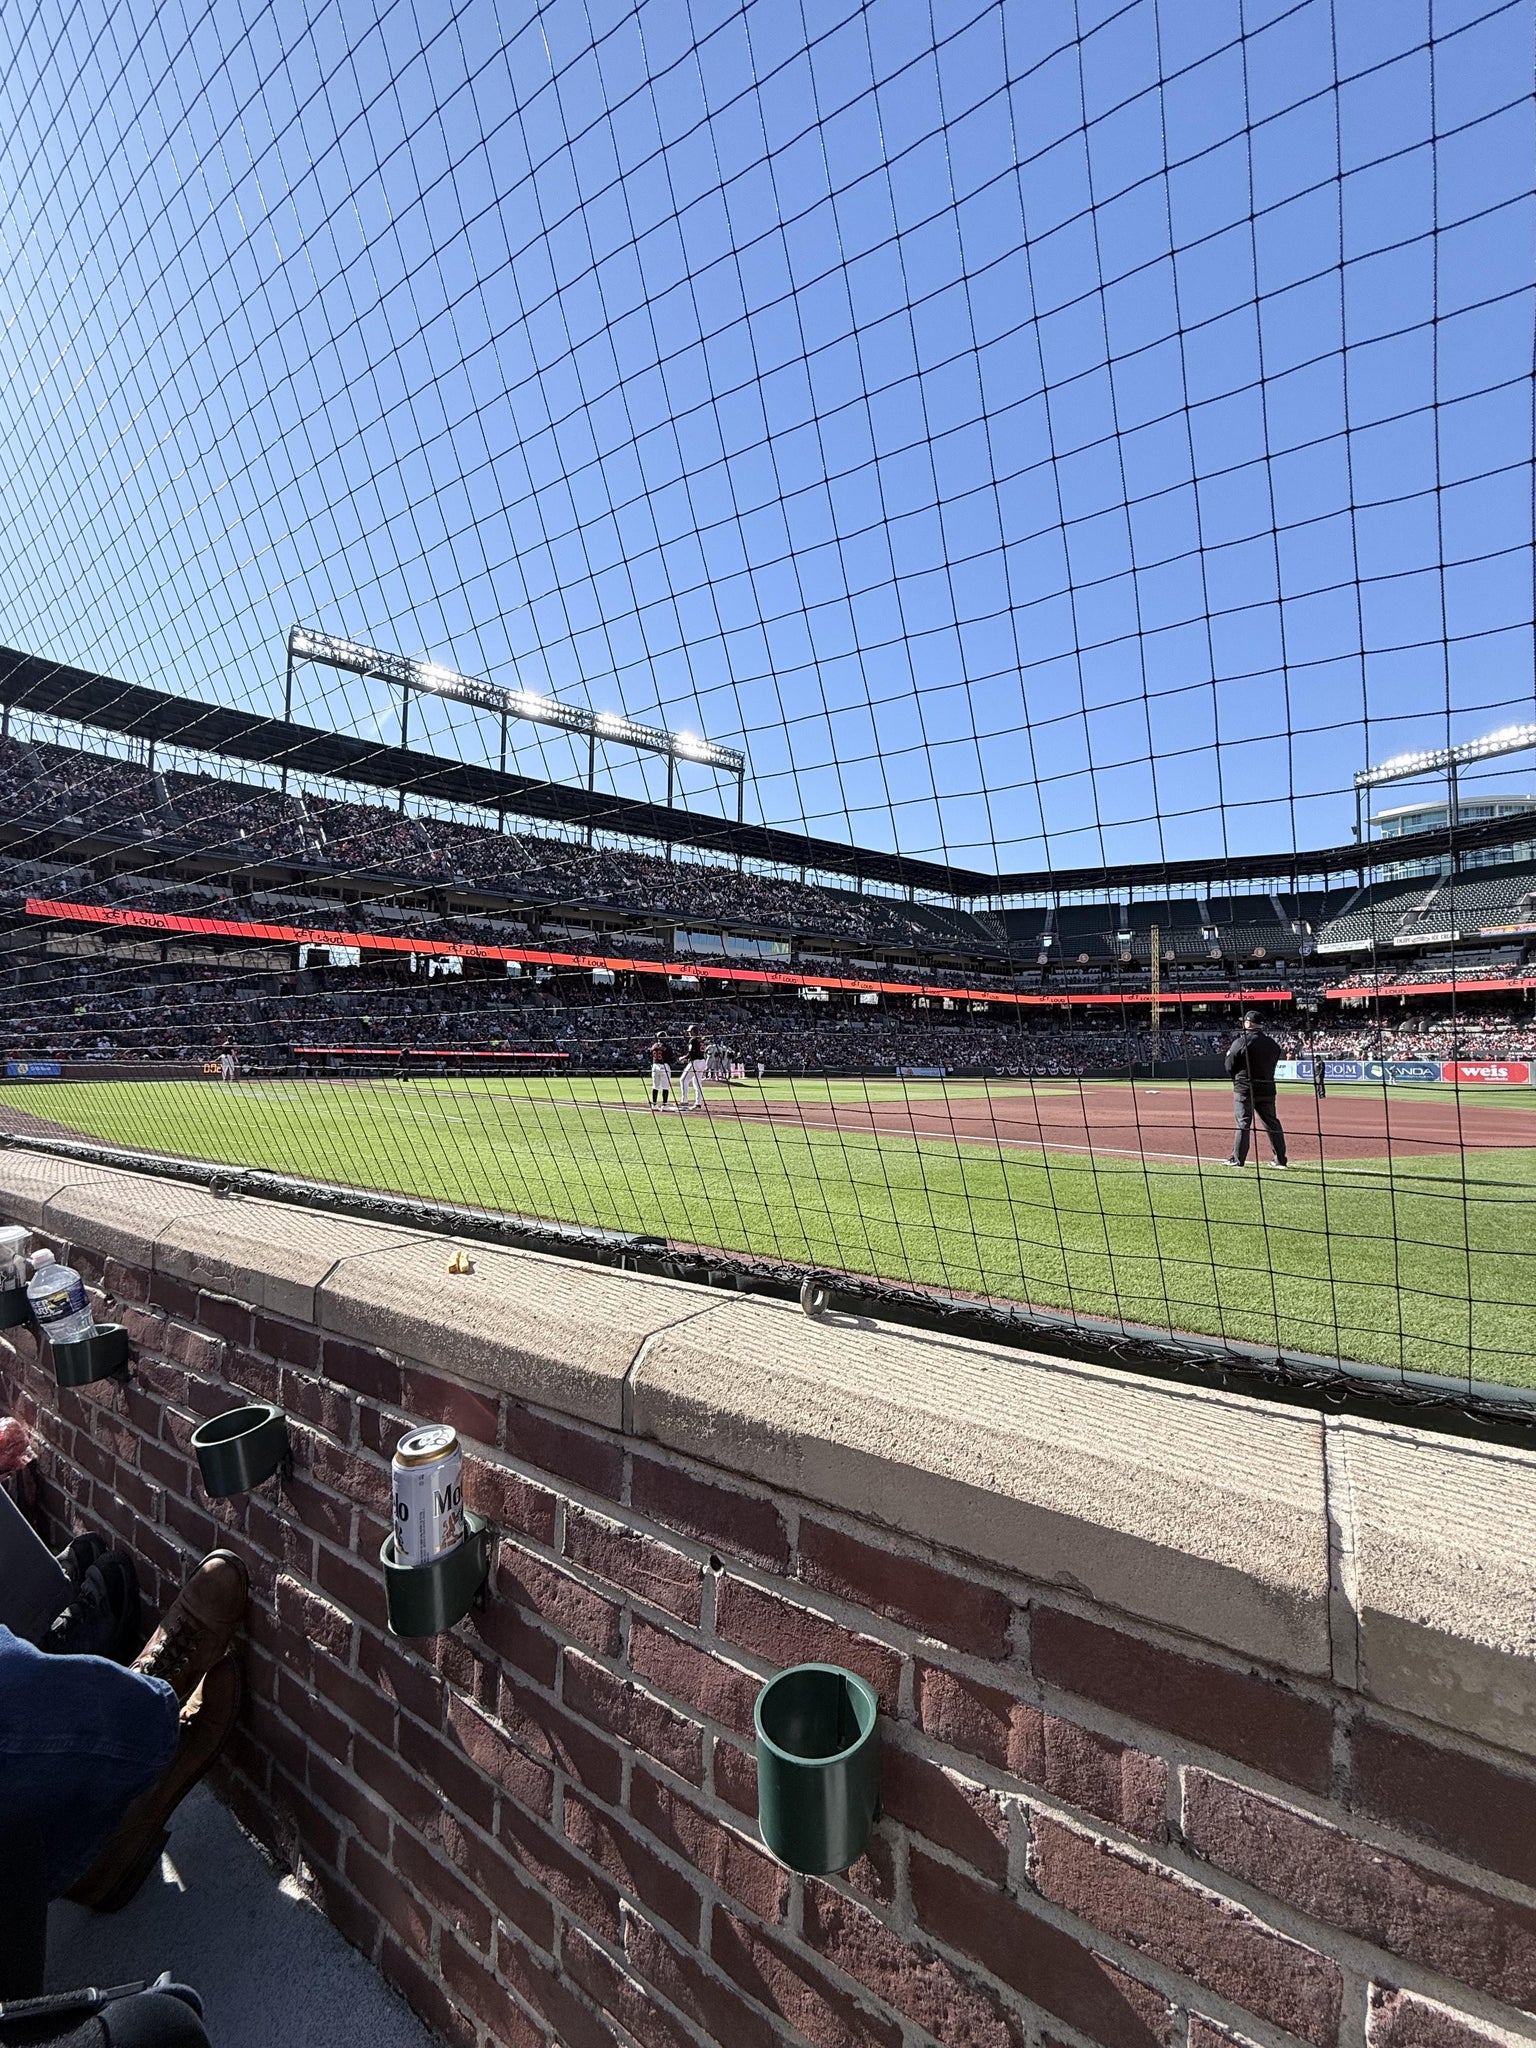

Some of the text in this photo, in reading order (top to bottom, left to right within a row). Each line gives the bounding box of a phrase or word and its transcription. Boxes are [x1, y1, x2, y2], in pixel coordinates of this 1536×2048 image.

[132, 916, 166, 928] LOUD
[317, 934, 344, 944] LOUD
[587, 959, 606, 967] LOUD
[1302, 1064, 1357, 1074] LCOM
[1461, 1064, 1508, 1077] weis
[30, 1299, 49, 1309] EER
[33, 1305, 54, 1316] ARK
